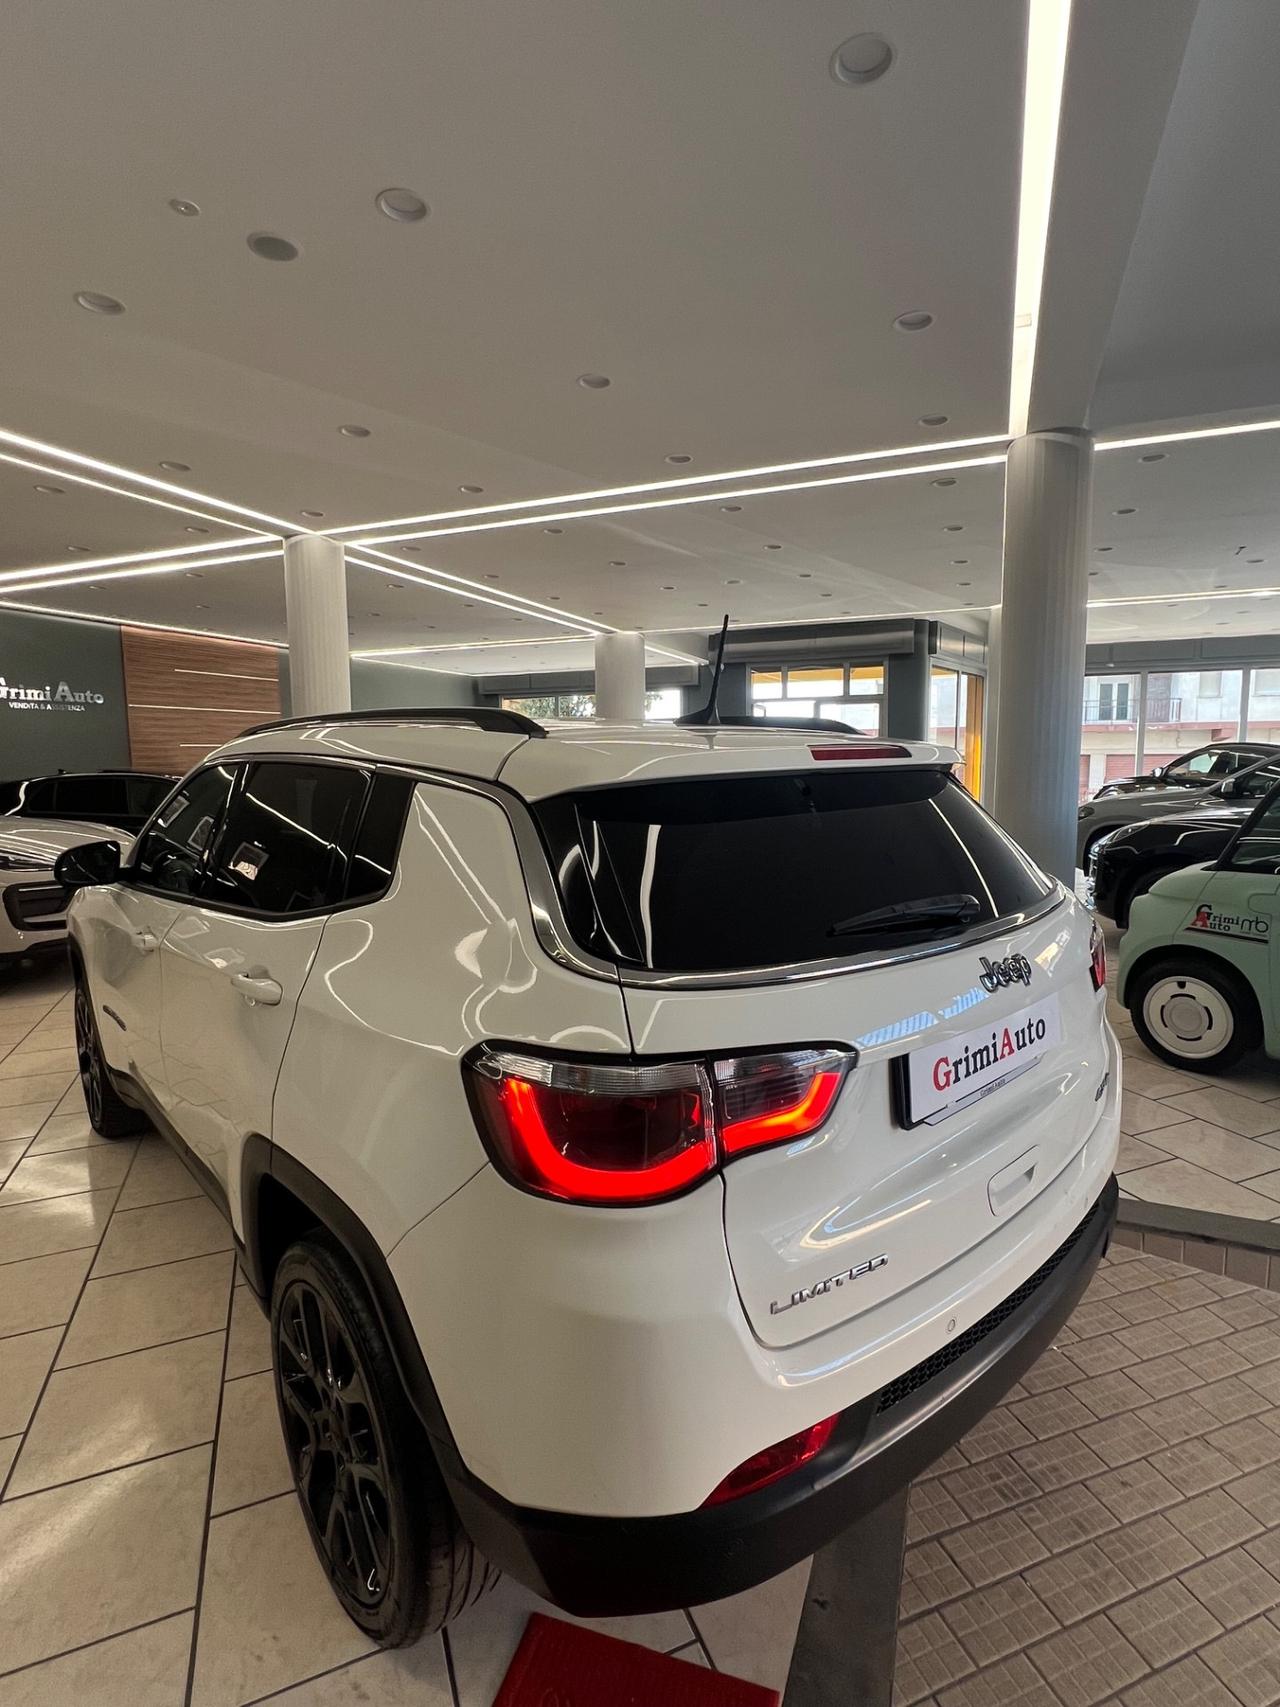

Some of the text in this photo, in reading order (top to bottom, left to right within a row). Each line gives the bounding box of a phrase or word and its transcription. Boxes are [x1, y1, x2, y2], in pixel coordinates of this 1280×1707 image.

[53, 681, 104, 704] Auto
[979, 953, 1032, 992] Jeep
[932, 1018, 1046, 1092] GrimiAuto
[769, 1253, 889, 1316] LIMITED
